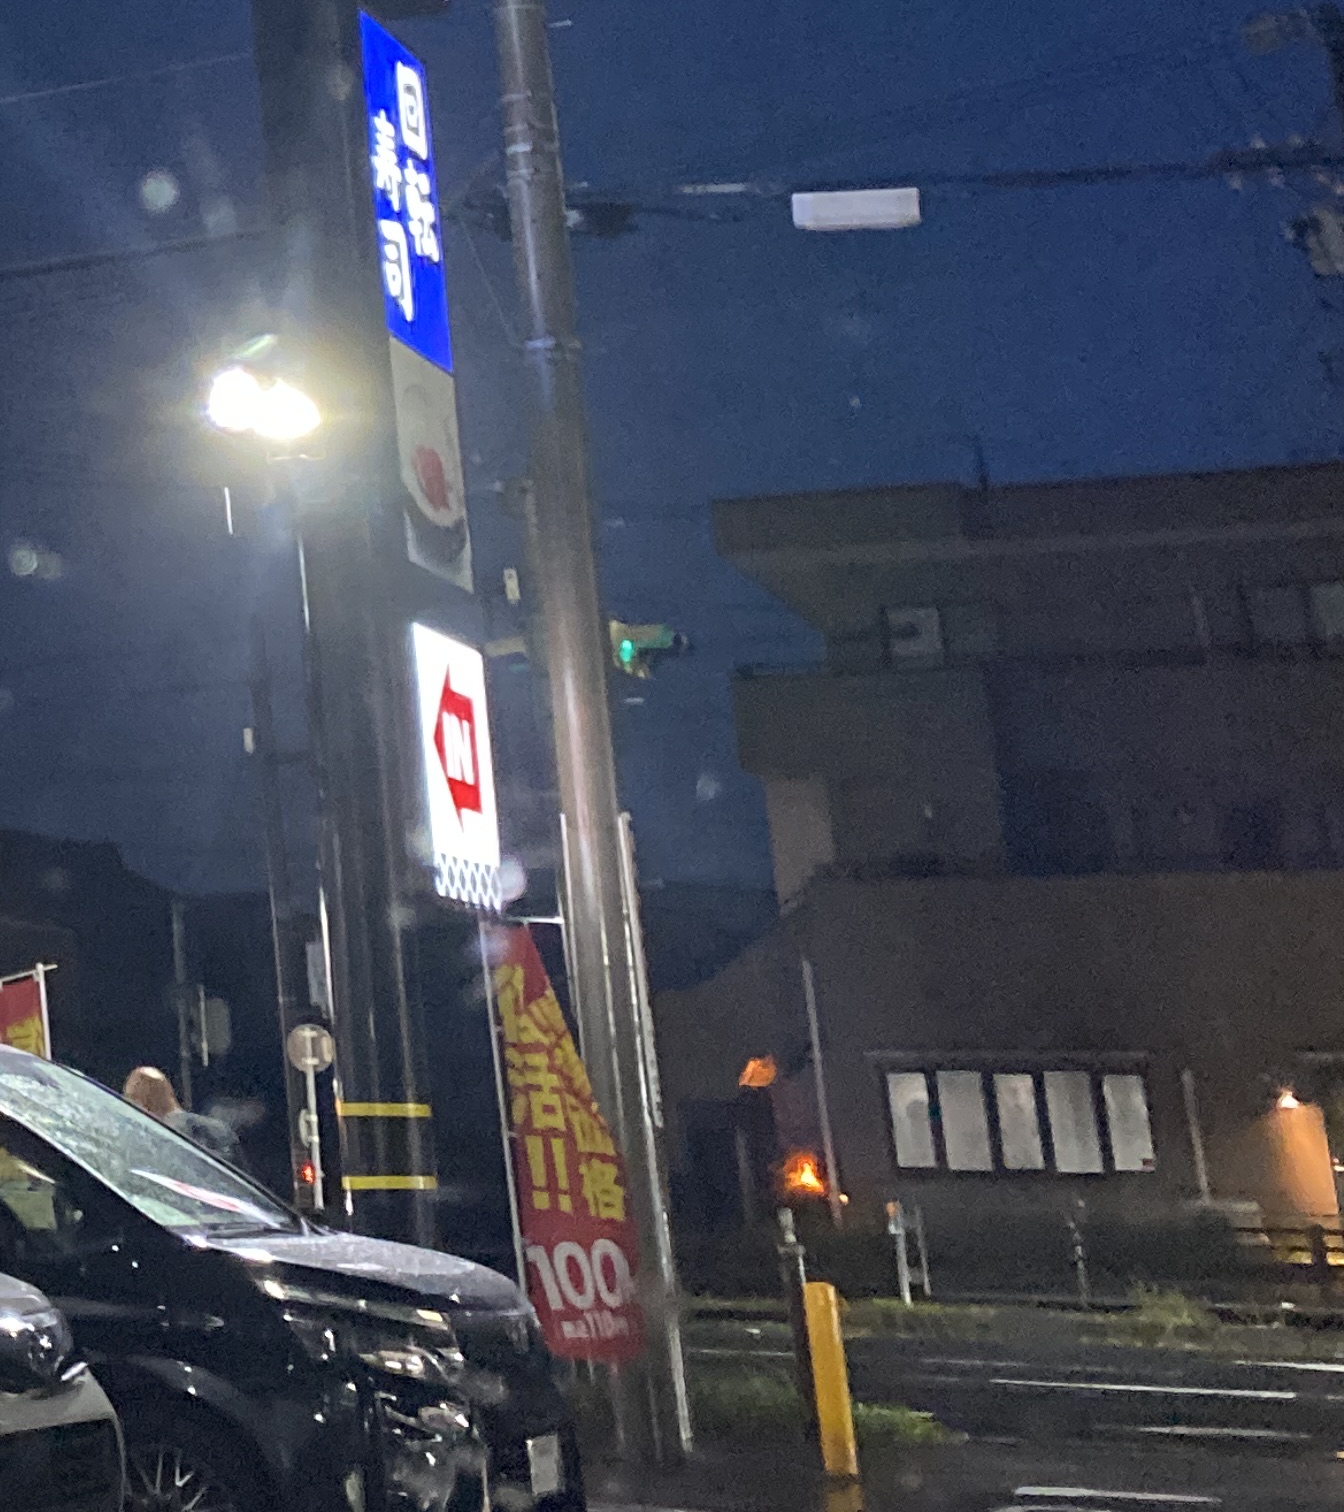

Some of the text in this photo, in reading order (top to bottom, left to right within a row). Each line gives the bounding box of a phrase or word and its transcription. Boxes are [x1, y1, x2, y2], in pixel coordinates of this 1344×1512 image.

[370, 108, 415, 323] 寿司
[395, 60, 441, 264] 回転
[441, 710, 475, 786] IN
